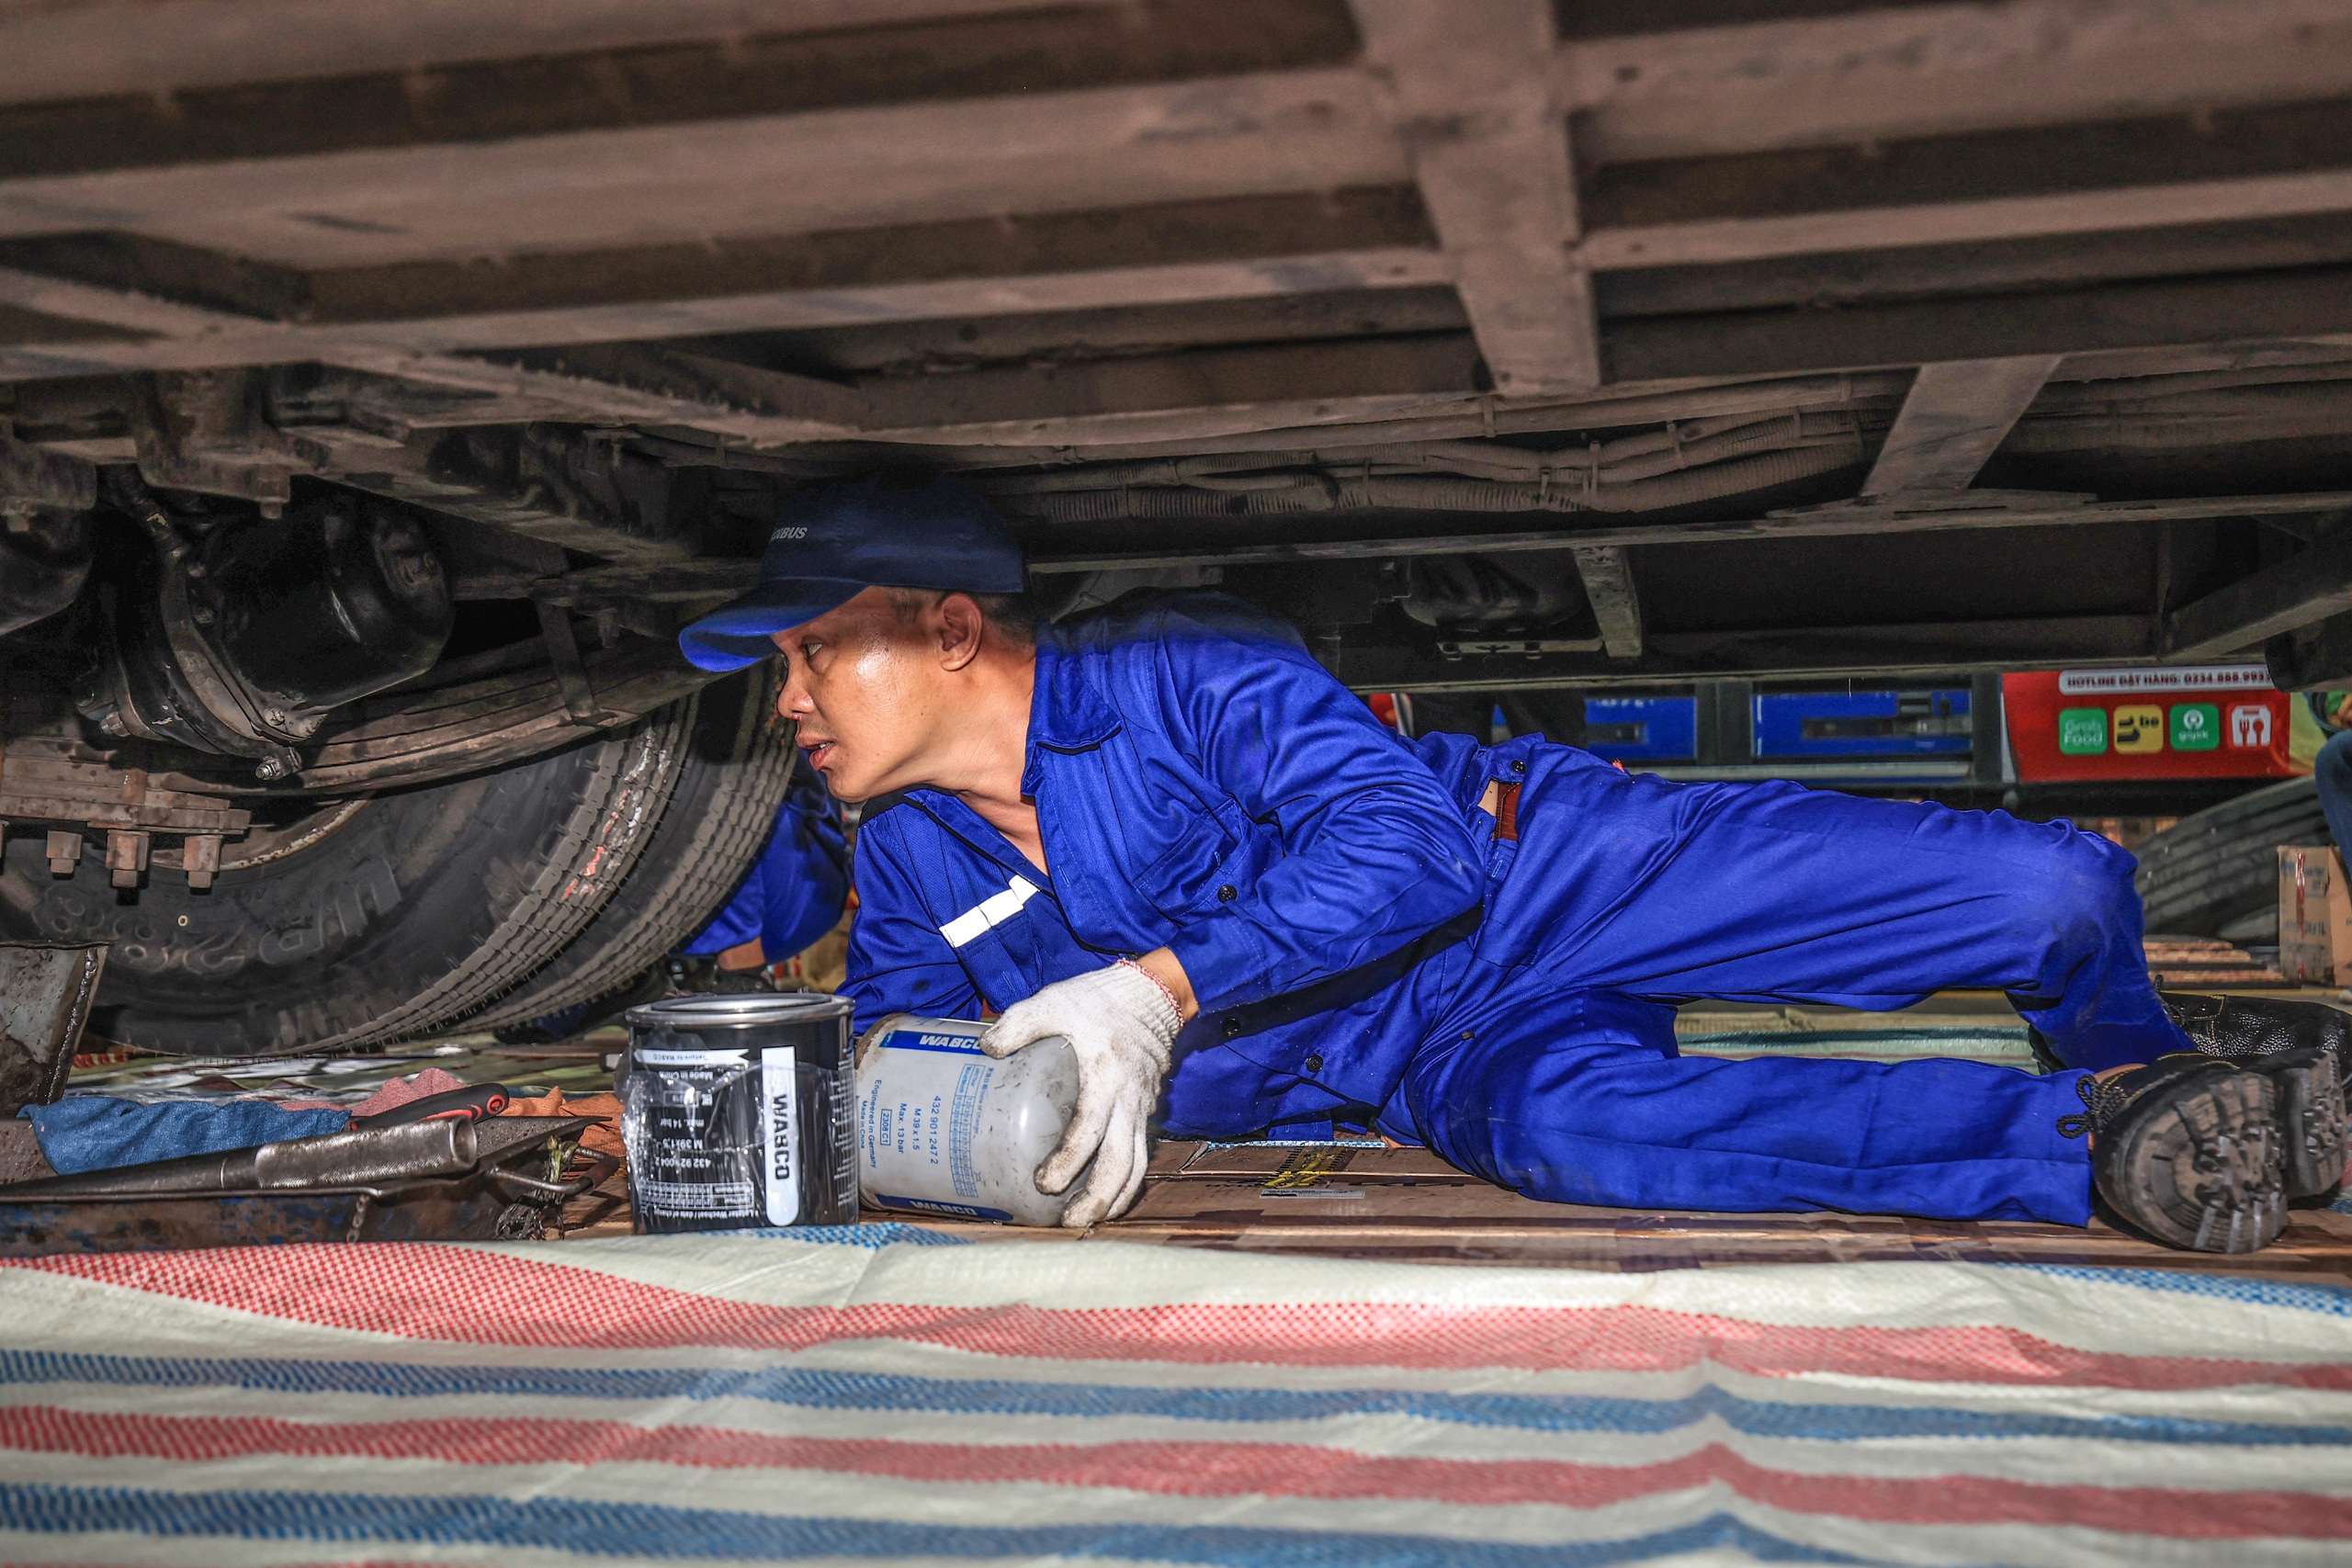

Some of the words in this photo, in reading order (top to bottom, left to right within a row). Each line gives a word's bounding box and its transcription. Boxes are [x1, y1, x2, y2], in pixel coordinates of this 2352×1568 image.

[2067, 674, 2117, 689] HOTLINE
[2064, 719, 2102, 732] Grab
[2064, 731, 2103, 747] Food
[680, 1071, 688, 1080] in
[690, 1071, 714, 1081] Made
[868, 1079, 882, 1124] Engineered
[931, 1095, 941, 1114] 432
[898, 1102, 908, 1123] Max.
[914, 1108, 922, 1116] M
[660, 1118, 672, 1128] bar
[673, 1118, 683, 1128] 14
[912, 1117, 921, 1128] 39
[929, 1116, 938, 1134] 901
[772, 1094, 790, 1180] WABCO
[881, 1133, 888, 1143] C1
[898, 1127, 905, 1137] 13
[693, 1139, 703, 1149] M
[929, 1138, 938, 1156] 247
[868, 1134, 877, 1168] Germany
[675, 1158, 692, 1168] 92
[693, 1158, 711, 1168] 432
[910, 1201, 978, 1216] WABCO
